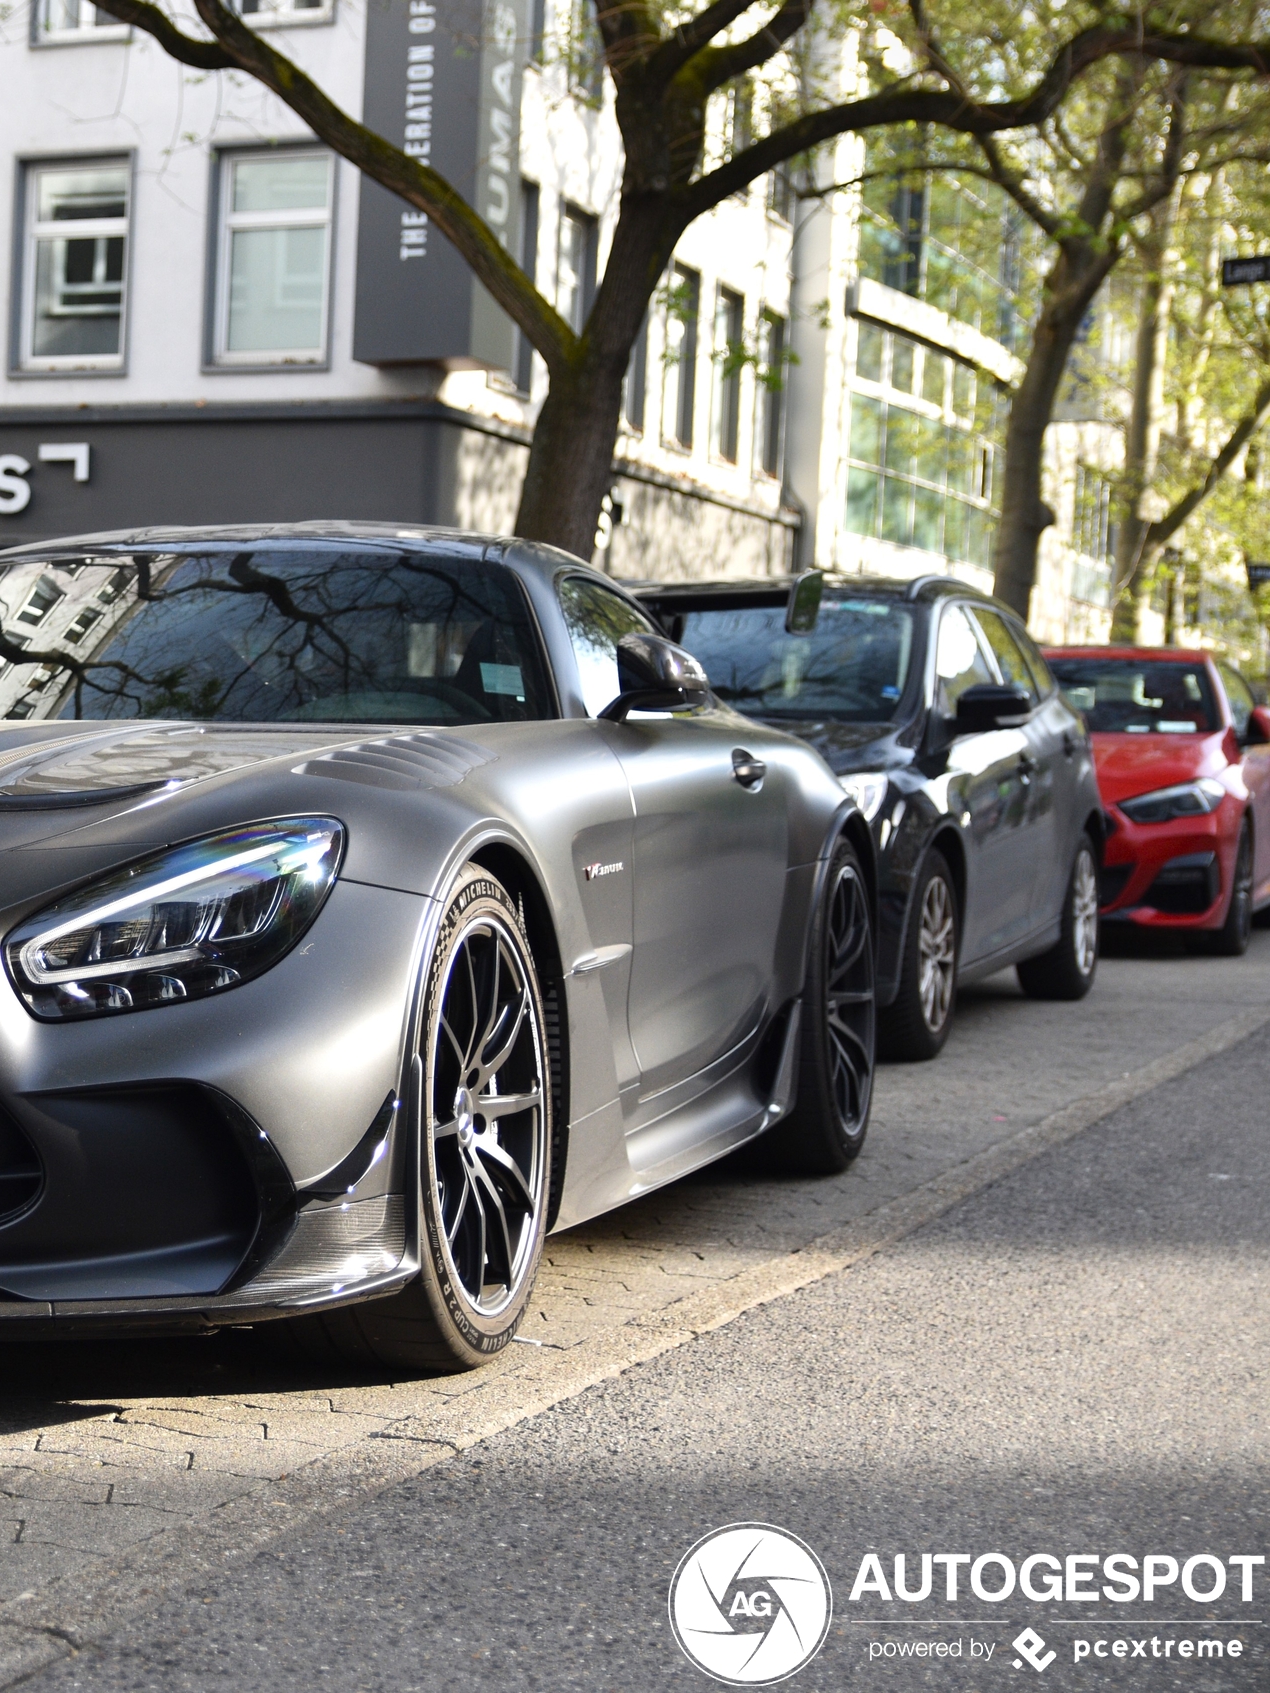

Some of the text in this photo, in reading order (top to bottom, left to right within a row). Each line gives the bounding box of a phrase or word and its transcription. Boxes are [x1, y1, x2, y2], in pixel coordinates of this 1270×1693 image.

[400, 0, 436, 261] THE ERATION OF
[486, 3, 517, 250] UMAS
[459, 882, 501, 910] MICHELIN
[443, 1282, 469, 1330] CUP 2 R
